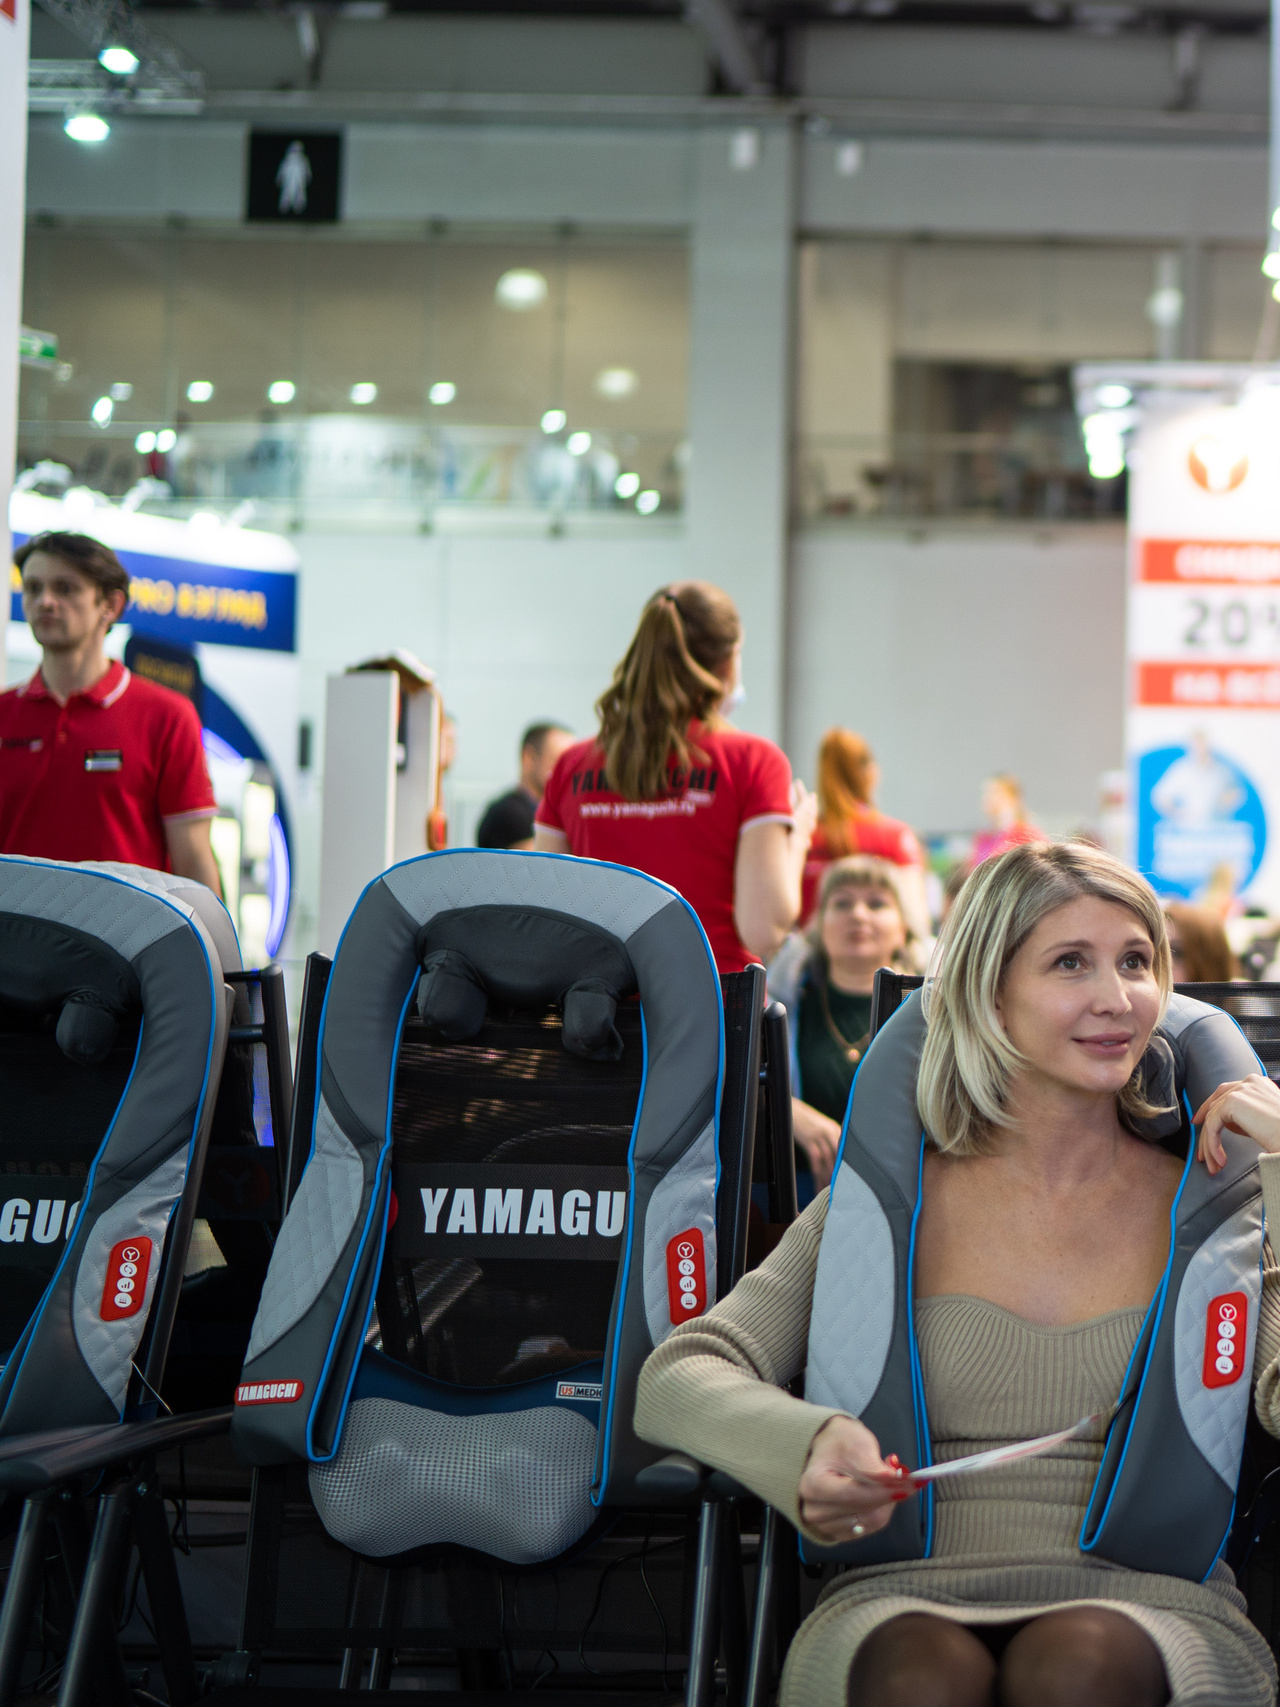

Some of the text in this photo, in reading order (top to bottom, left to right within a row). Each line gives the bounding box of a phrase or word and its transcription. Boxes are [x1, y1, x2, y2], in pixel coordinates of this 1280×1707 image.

[420, 1188, 626, 1237] YAMAGU
[238, 1382, 298, 1401] YAMAGUCHI
[561, 1386, 573, 1395] US
